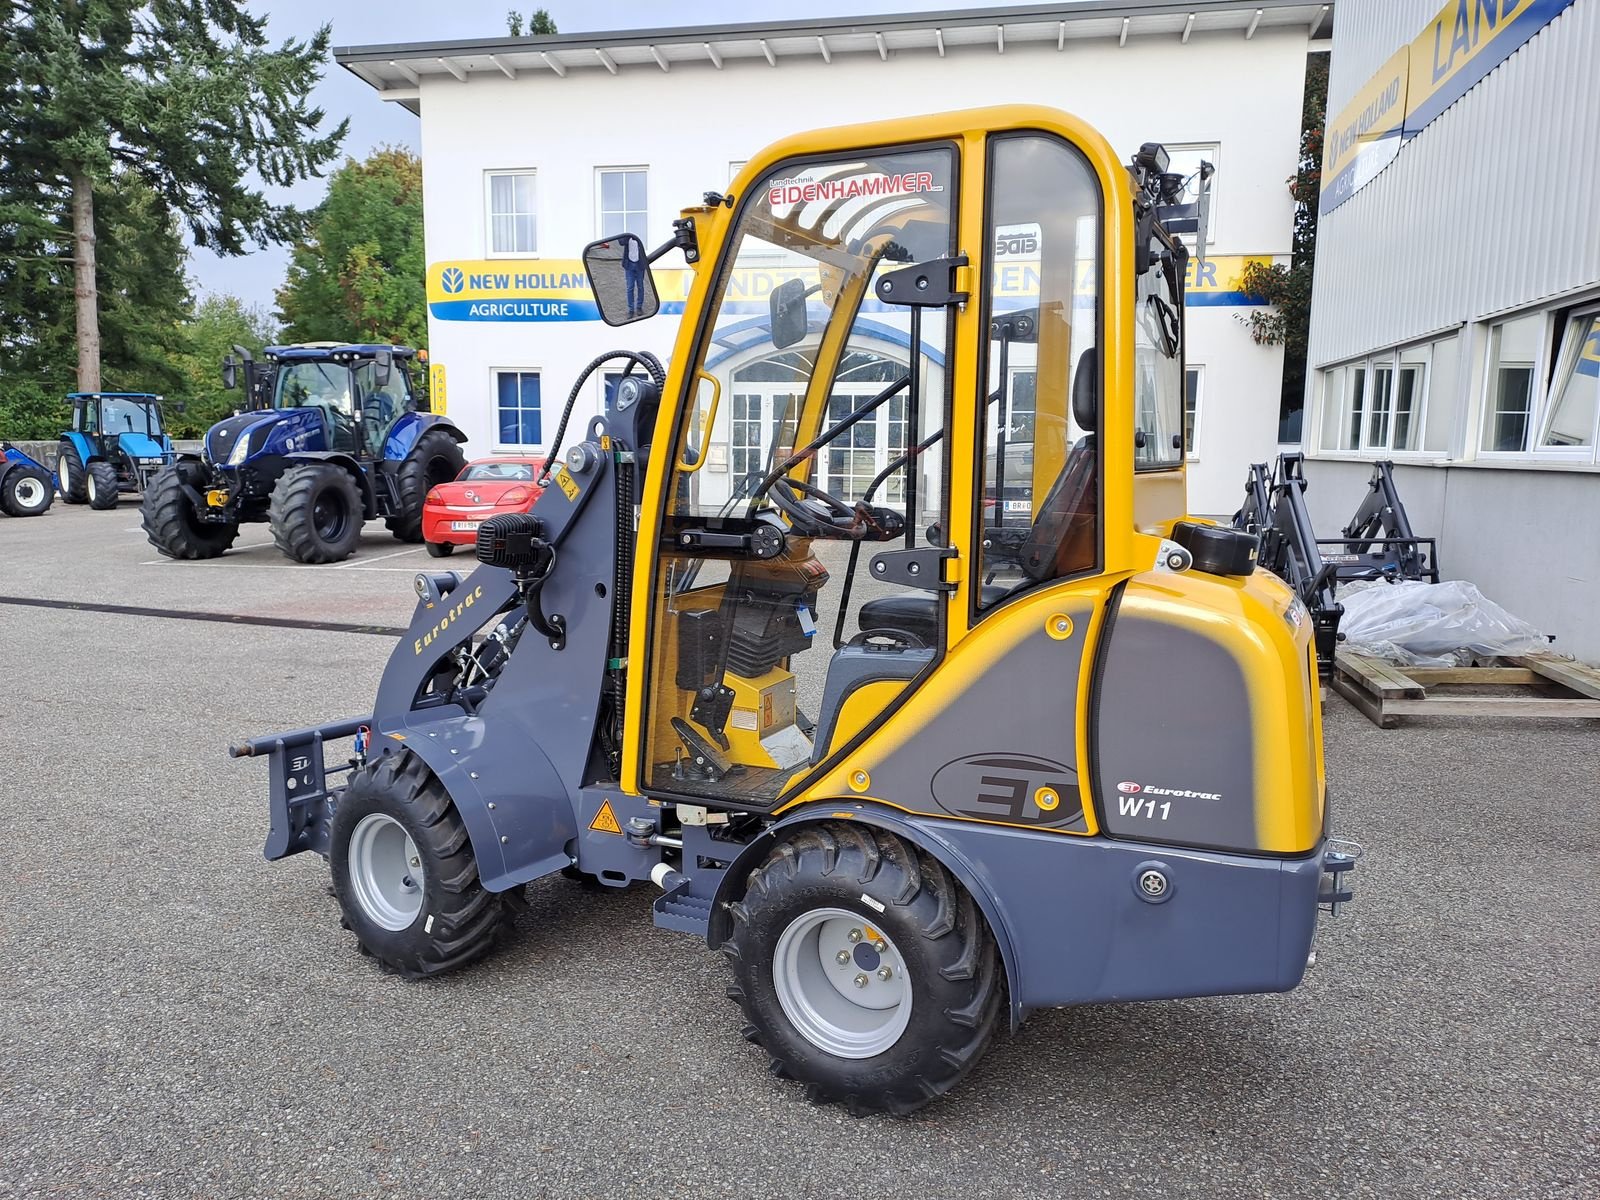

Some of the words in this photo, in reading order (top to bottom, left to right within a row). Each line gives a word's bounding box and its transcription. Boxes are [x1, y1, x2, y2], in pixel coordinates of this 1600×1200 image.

[1340, 117, 1359, 154] NEW
[1360, 76, 1400, 135] HOLLAND
[769, 173, 932, 205] EIDENHAMMER
[770, 176, 814, 187] Landtechnik
[470, 274, 510, 289] NEW
[469, 303, 569, 317] AGRICULTURE
[437, 368, 445, 411] PARTS
[414, 585, 482, 656] Eurotrac
[1143, 784, 1222, 801] Eurotrac
[1119, 796, 1171, 821] W11
